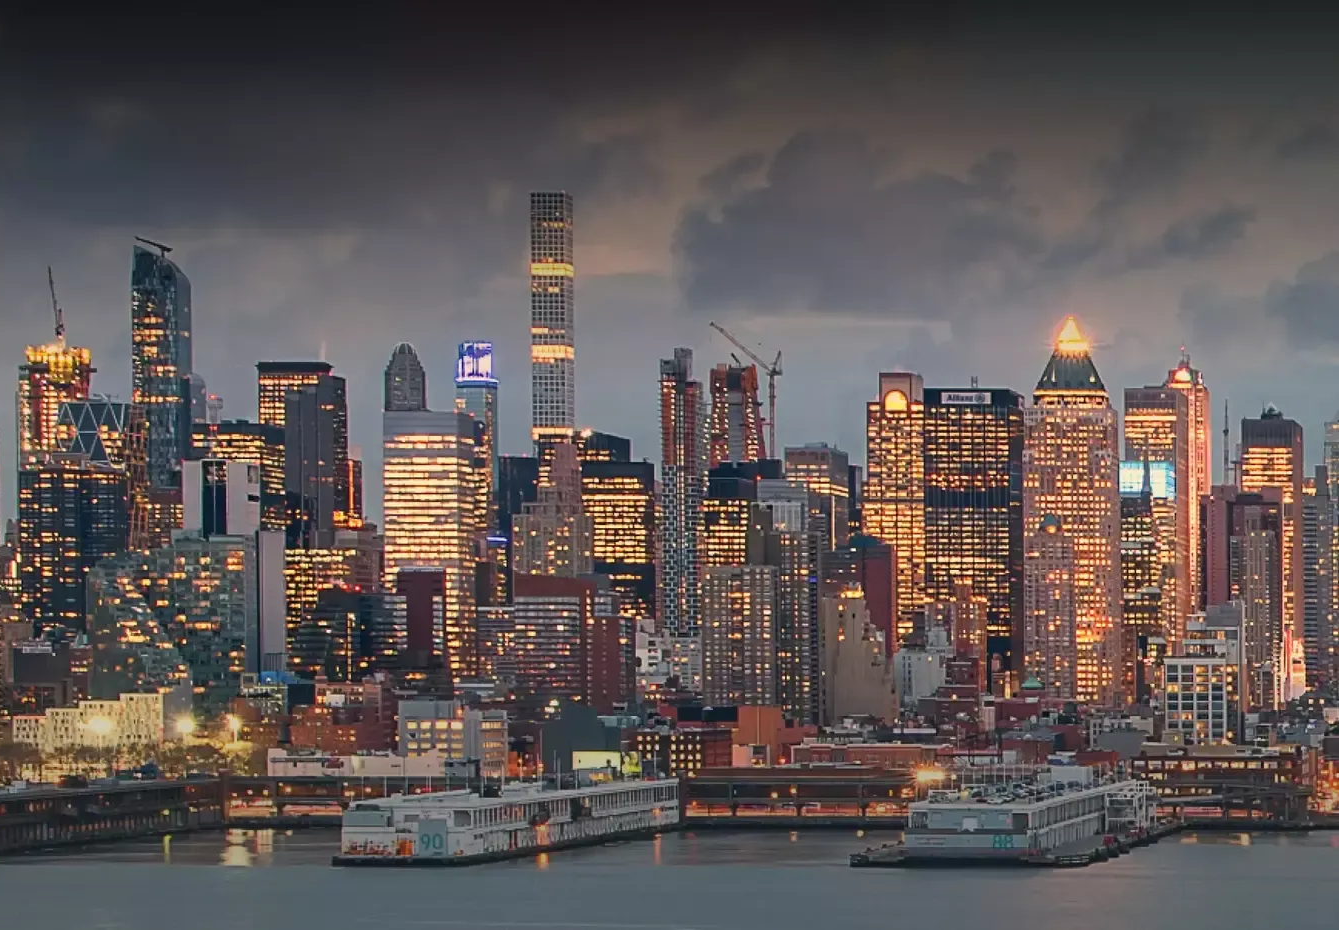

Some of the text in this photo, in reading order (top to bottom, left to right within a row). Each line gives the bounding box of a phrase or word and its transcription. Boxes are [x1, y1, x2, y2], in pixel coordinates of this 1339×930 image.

[947, 394, 973, 402] Allianz
[421, 833, 443, 850] 90
[993, 834, 1013, 848] 88
